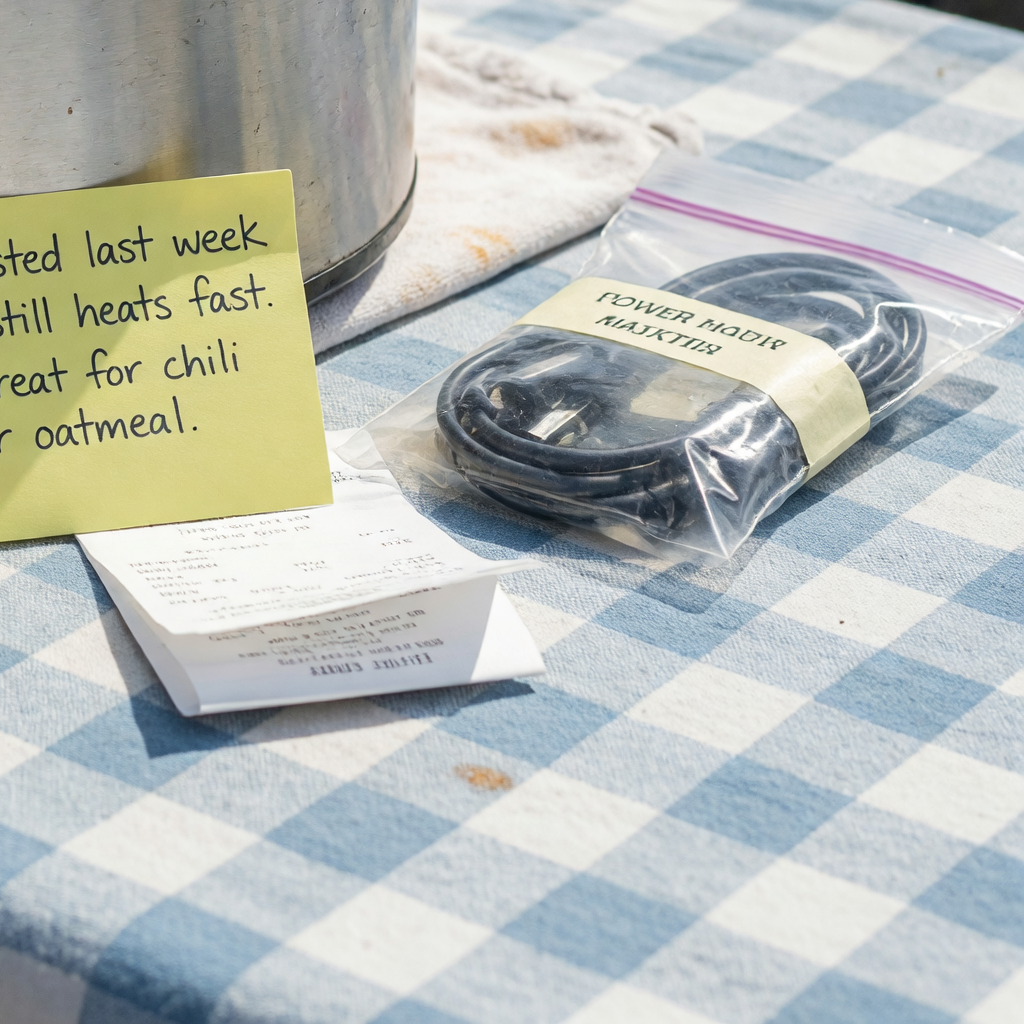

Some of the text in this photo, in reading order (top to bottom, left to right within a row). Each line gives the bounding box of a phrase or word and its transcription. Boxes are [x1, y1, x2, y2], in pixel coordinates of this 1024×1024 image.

[85, 225, 154, 268] last
[171, 213, 268, 257] week
[73, 284, 172, 328] heats
[188, 273, 274, 317] fast.
[85, 347, 143, 389] for
[164, 337, 239, 380] chili
[34, 395, 199, 450] oatmeal.
